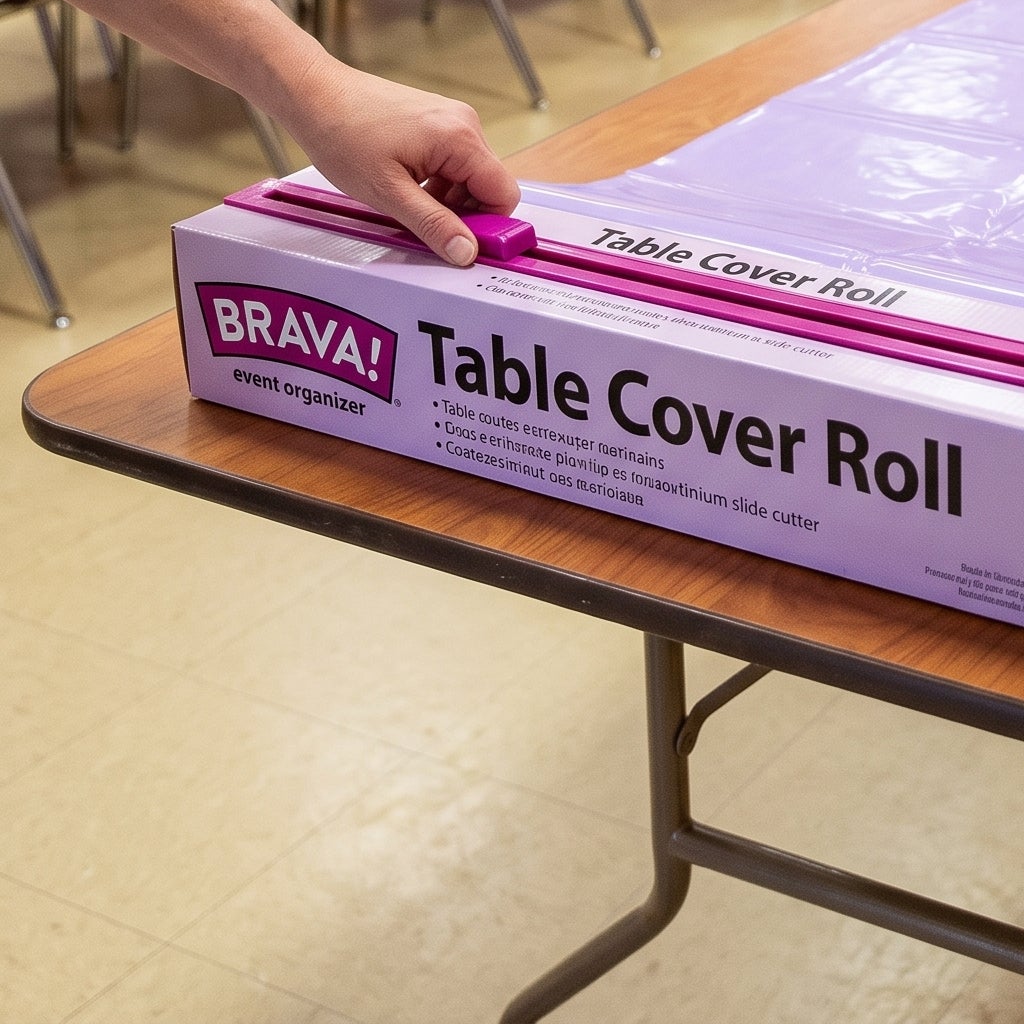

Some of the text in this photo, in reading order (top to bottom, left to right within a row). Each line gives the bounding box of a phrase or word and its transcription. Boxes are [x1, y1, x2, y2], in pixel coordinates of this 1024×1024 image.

[590, 228, 907, 308] Table Cover Roll
[213, 298, 382, 382] BRAVA!
[233, 368, 367, 416] event organizer
[417, 320, 963, 518] Table Cover Roll
[441, 399, 475, 421] Table
[732, 497, 768, 519] slide
[772, 510, 820, 532] cutter
